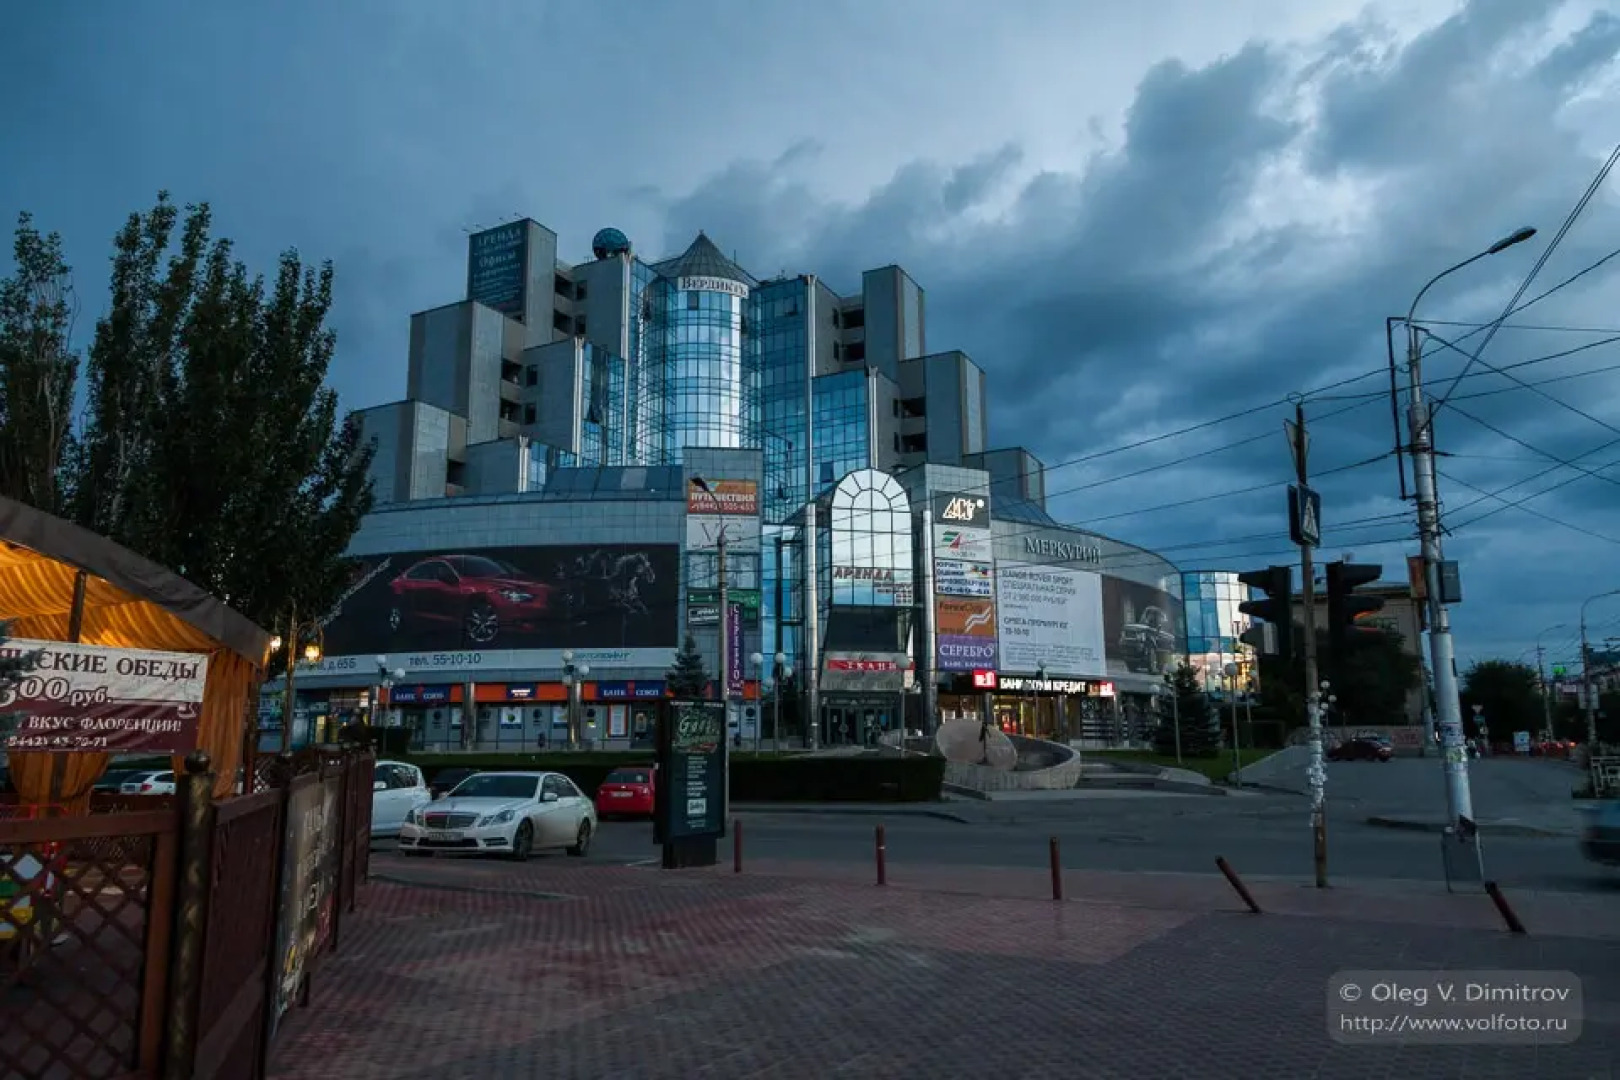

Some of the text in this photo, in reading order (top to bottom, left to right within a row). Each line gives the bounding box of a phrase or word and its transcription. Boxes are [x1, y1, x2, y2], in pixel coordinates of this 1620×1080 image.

[939, 644, 994, 658] СЕРЕБРО
[432, 653, 482, 666] 55-10-10
[116, 658, 200, 681] ОБЕДЫ
[1053, 681, 1086, 694] КРЕДИТ
[70, 686, 113, 706] руб.
[28, 716, 182, 733] ВКУС ФЛОРЕНЦИИ!
